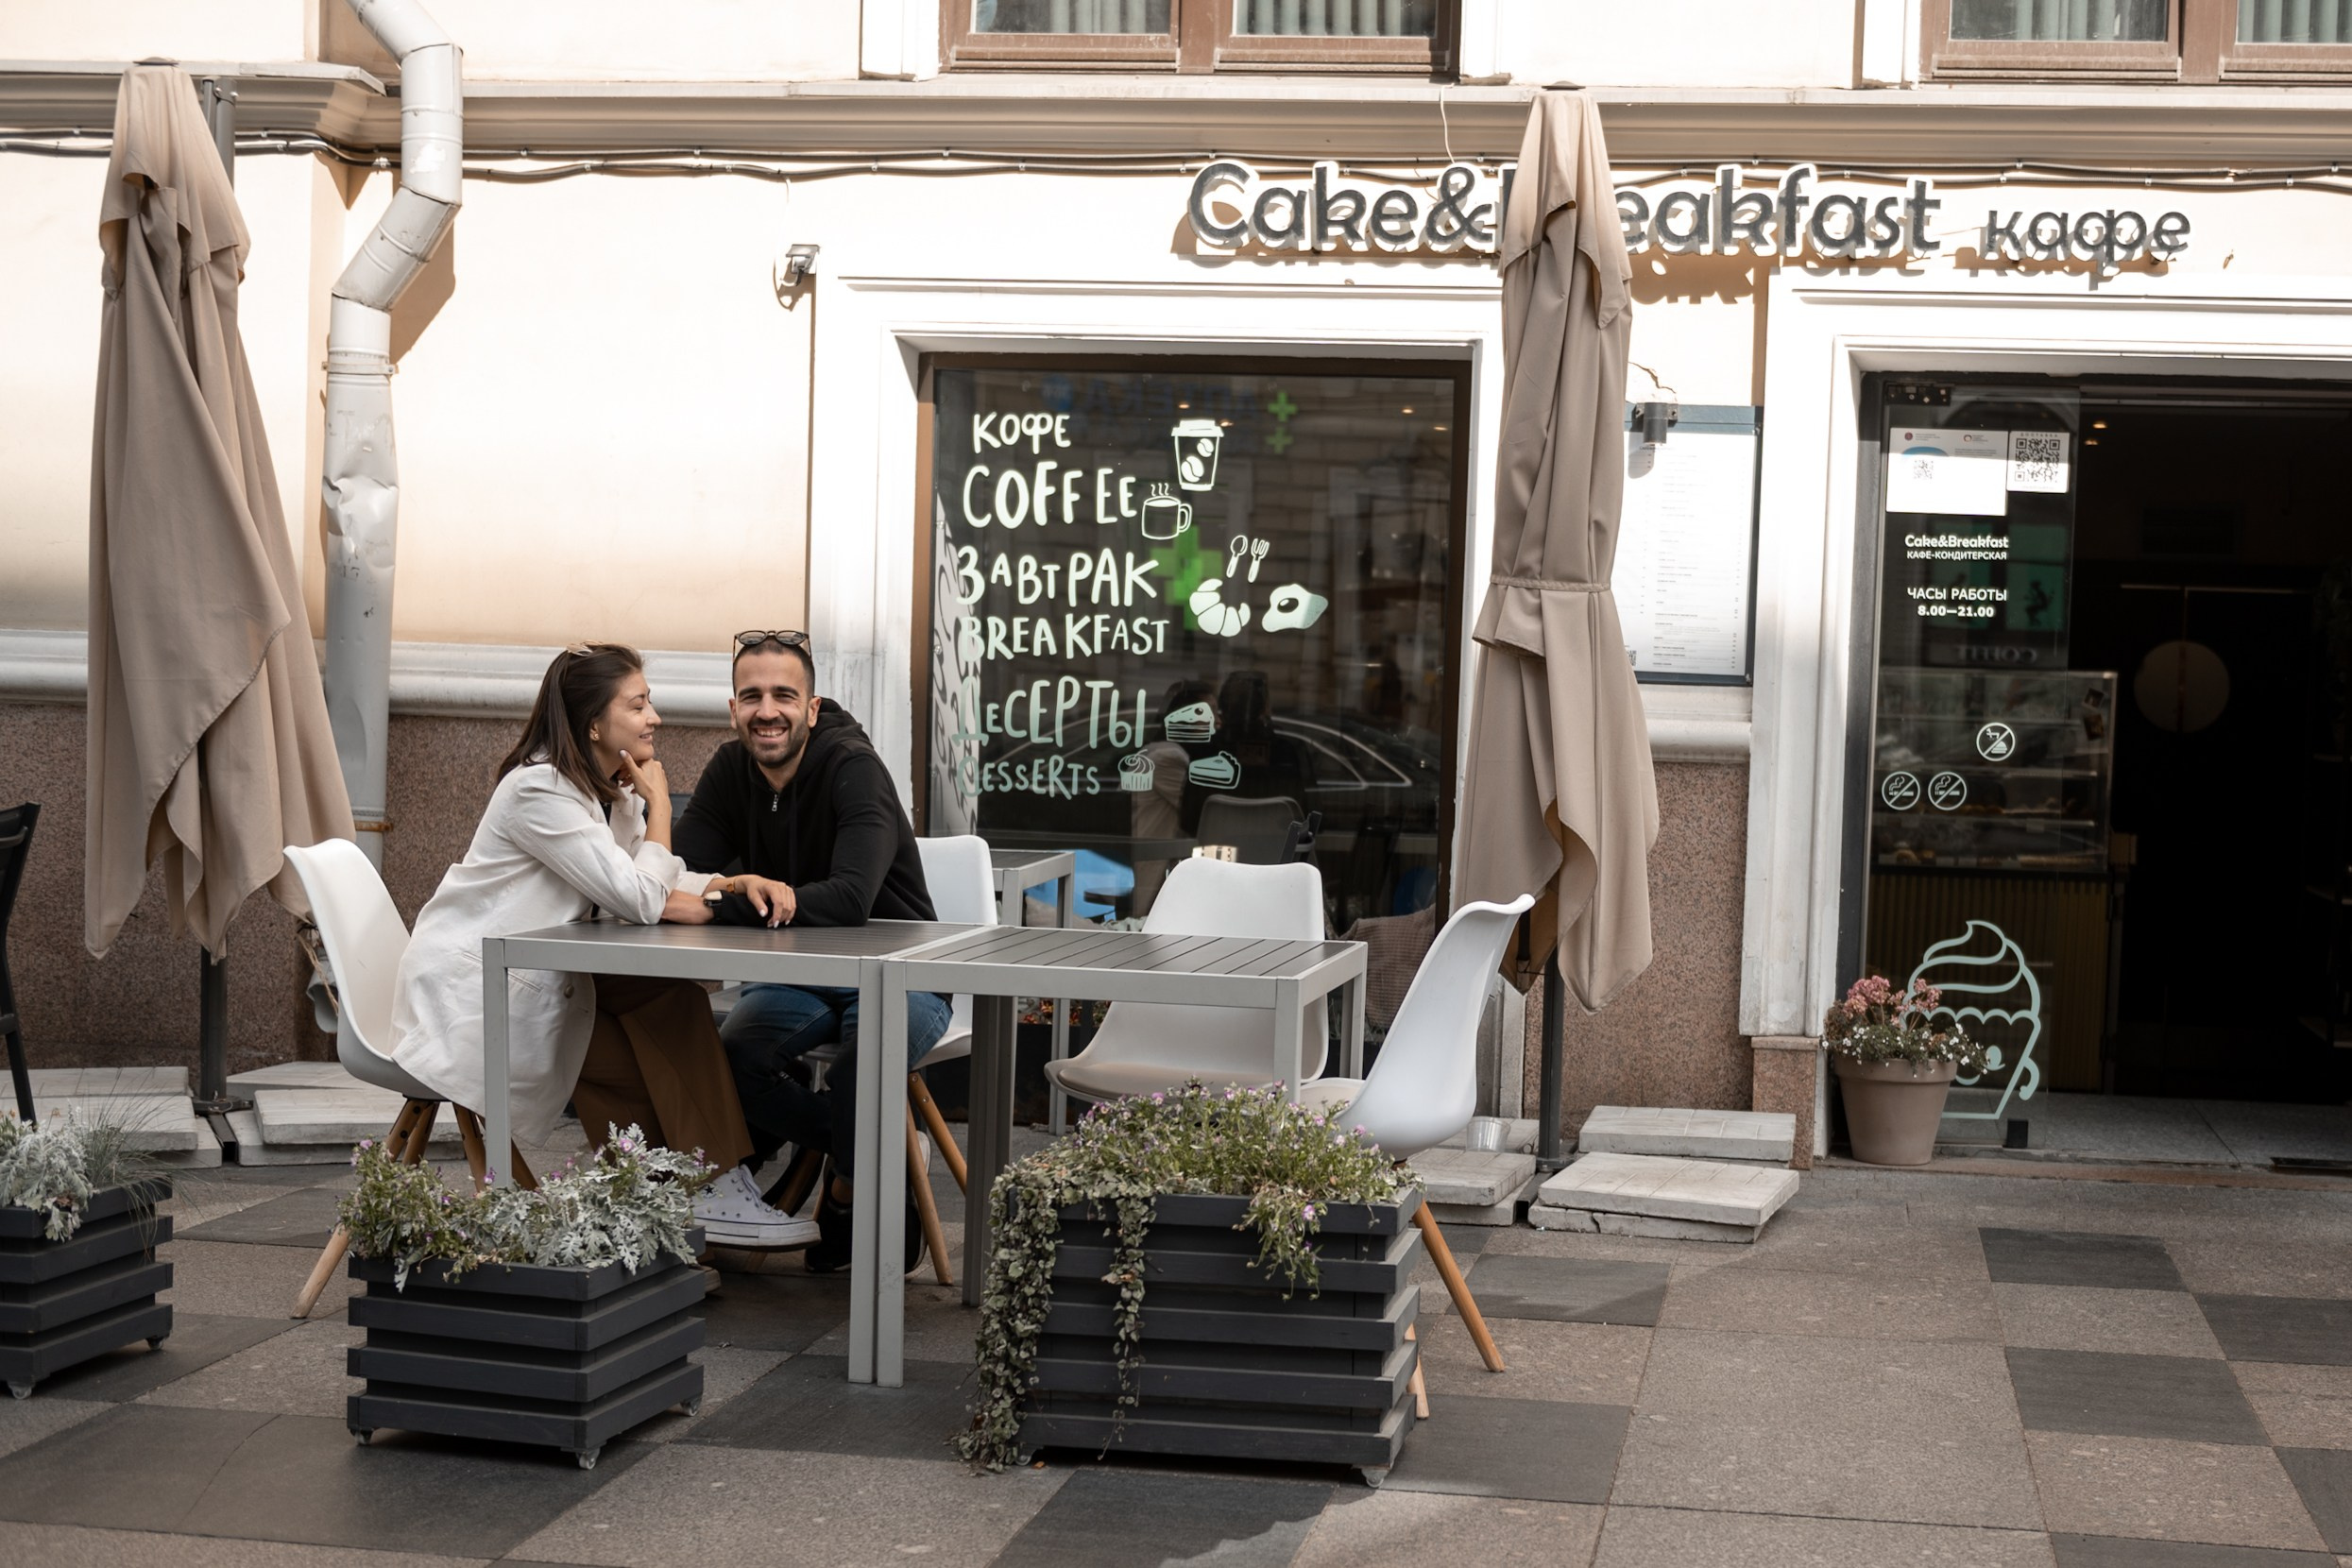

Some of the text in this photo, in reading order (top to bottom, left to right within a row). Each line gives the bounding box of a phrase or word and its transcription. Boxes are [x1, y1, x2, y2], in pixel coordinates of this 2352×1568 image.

[1188, 162, 1941, 251] Cake&eakfast
[1986, 208, 2191, 268] кафе
[973, 412, 1071, 454] КОФЕ
[963, 461, 1137, 529] COFFEE
[1904, 534, 2009, 549] Cake&Breakfast
[1906, 550, 2007, 560] КАФЕ-КОНДИТЕРСКАЯ
[956, 546, 1159, 607] ЗАВТРАК
[1907, 588, 2007, 601] ЧАСЫ РАБОТЫ
[960, 613, 1170, 662] BREAKFAST
